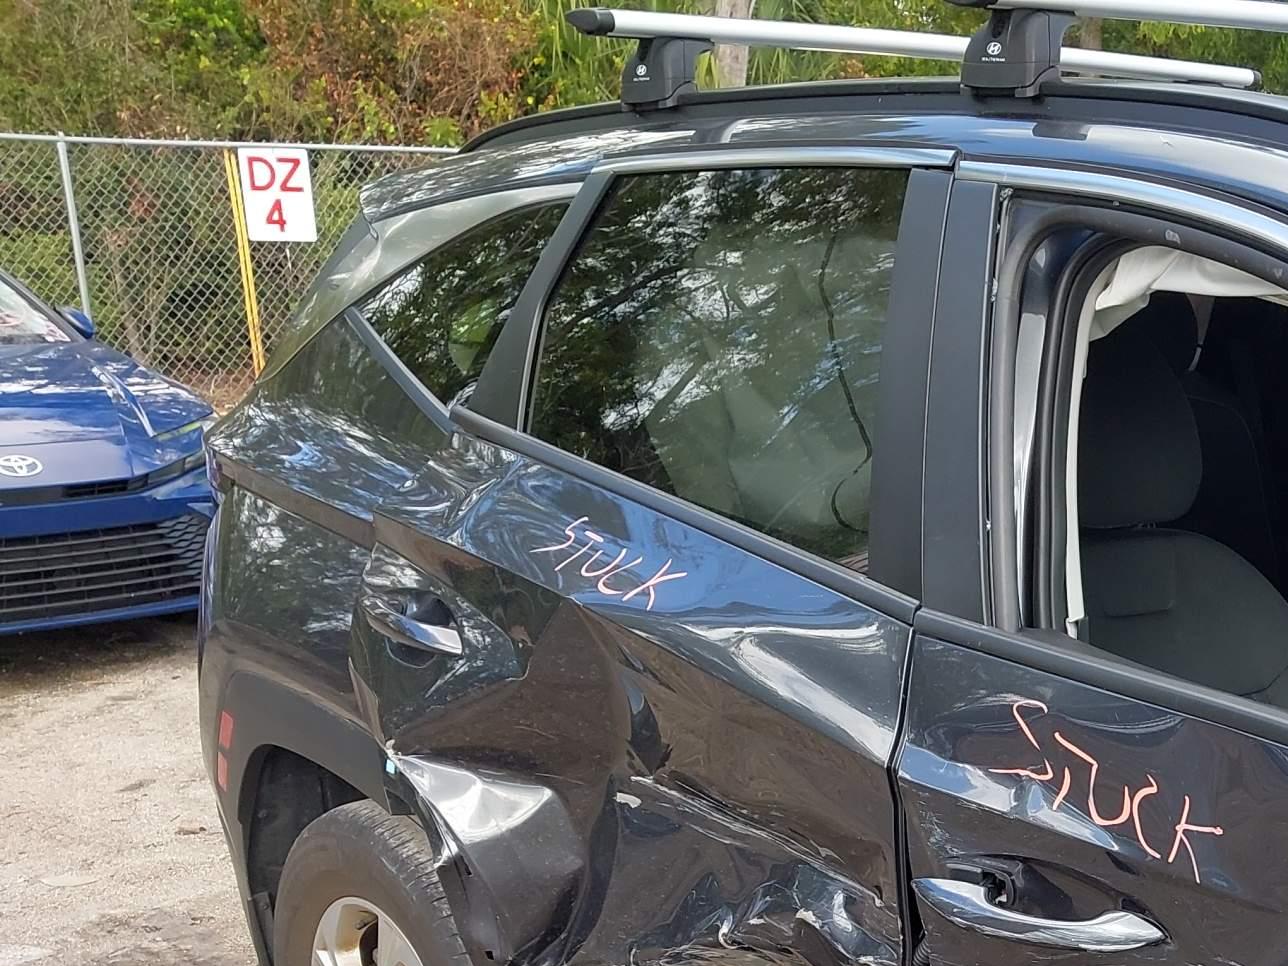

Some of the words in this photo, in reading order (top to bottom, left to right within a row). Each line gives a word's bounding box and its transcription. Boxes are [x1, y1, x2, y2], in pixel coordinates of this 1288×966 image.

[246, 156, 304, 192] DZ
[266, 198, 286, 232] 4
[529, 516, 688, 611] STUCK
[988, 699, 1224, 884] STUCK
